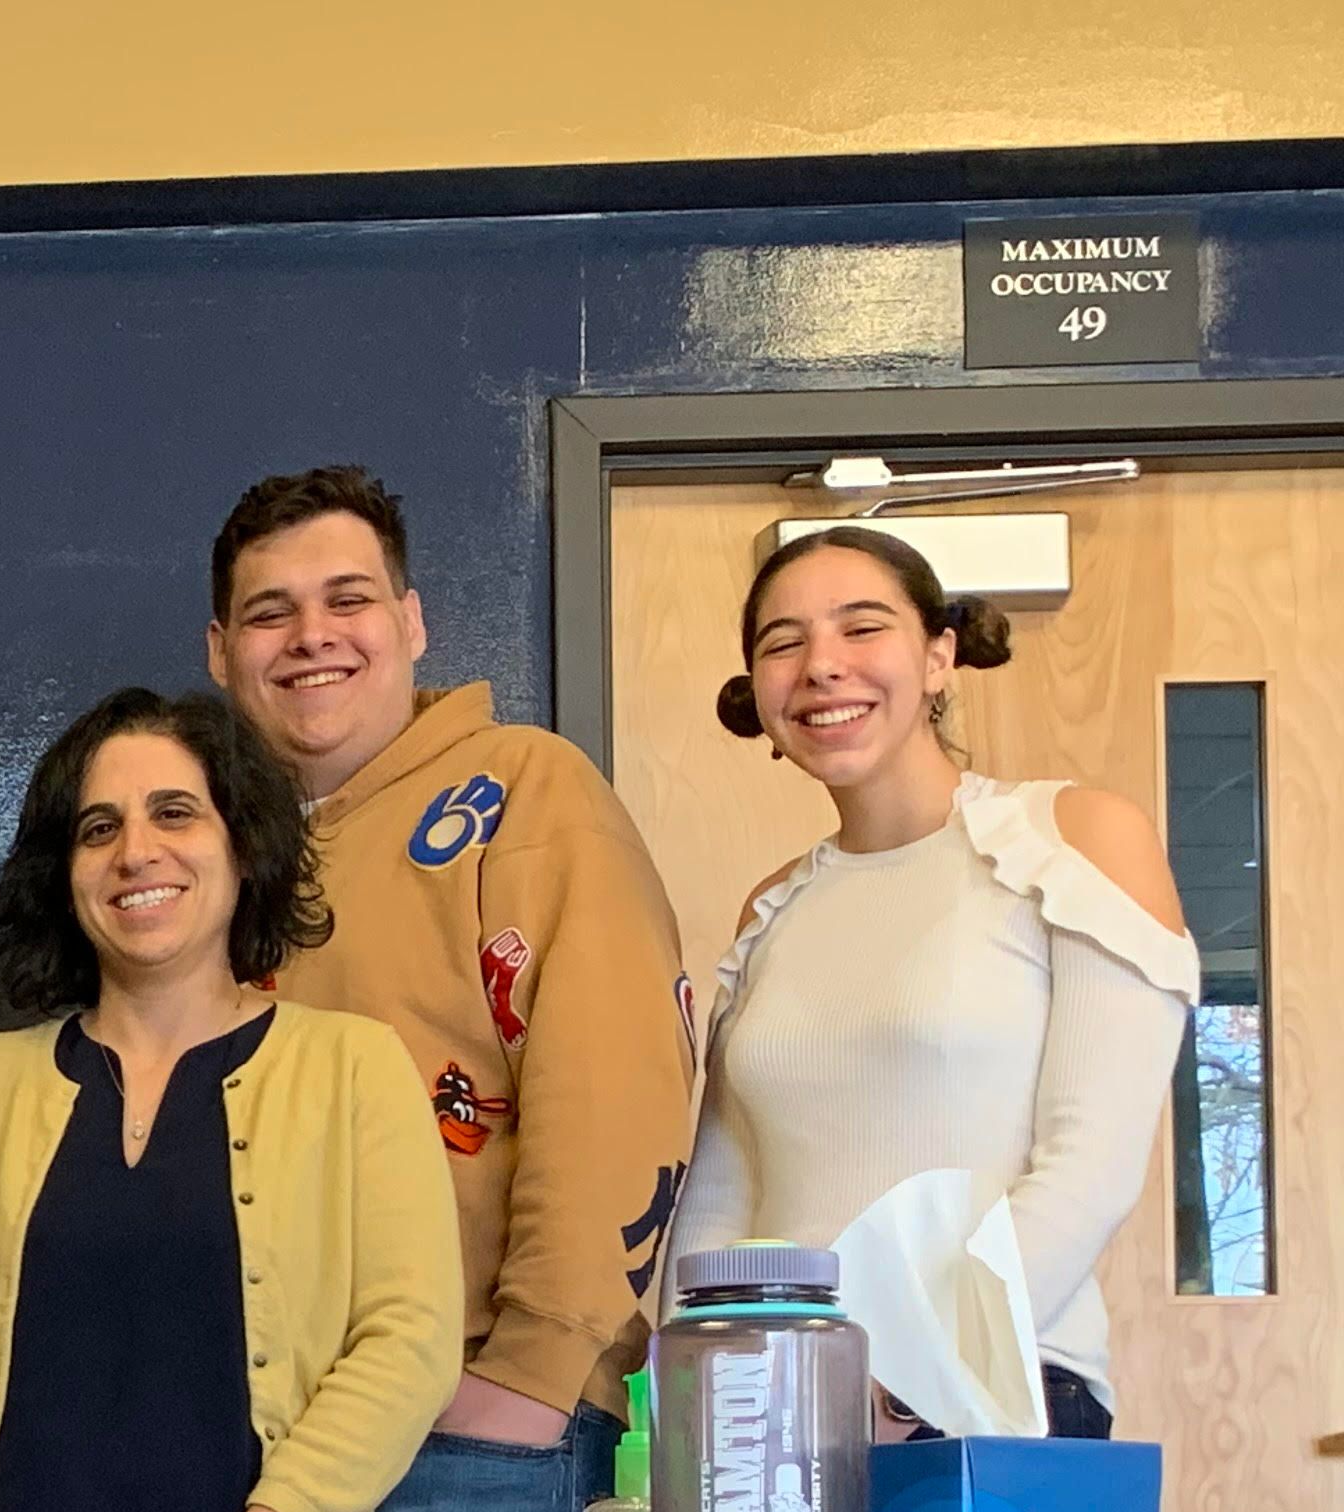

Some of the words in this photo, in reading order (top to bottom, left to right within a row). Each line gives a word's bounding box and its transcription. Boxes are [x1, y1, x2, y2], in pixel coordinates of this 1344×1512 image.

[1001, 236, 1161, 262] MAXIMUM
[991, 269, 1172, 296] OCCUPANCY
[1058, 306, 1107, 341] 49
